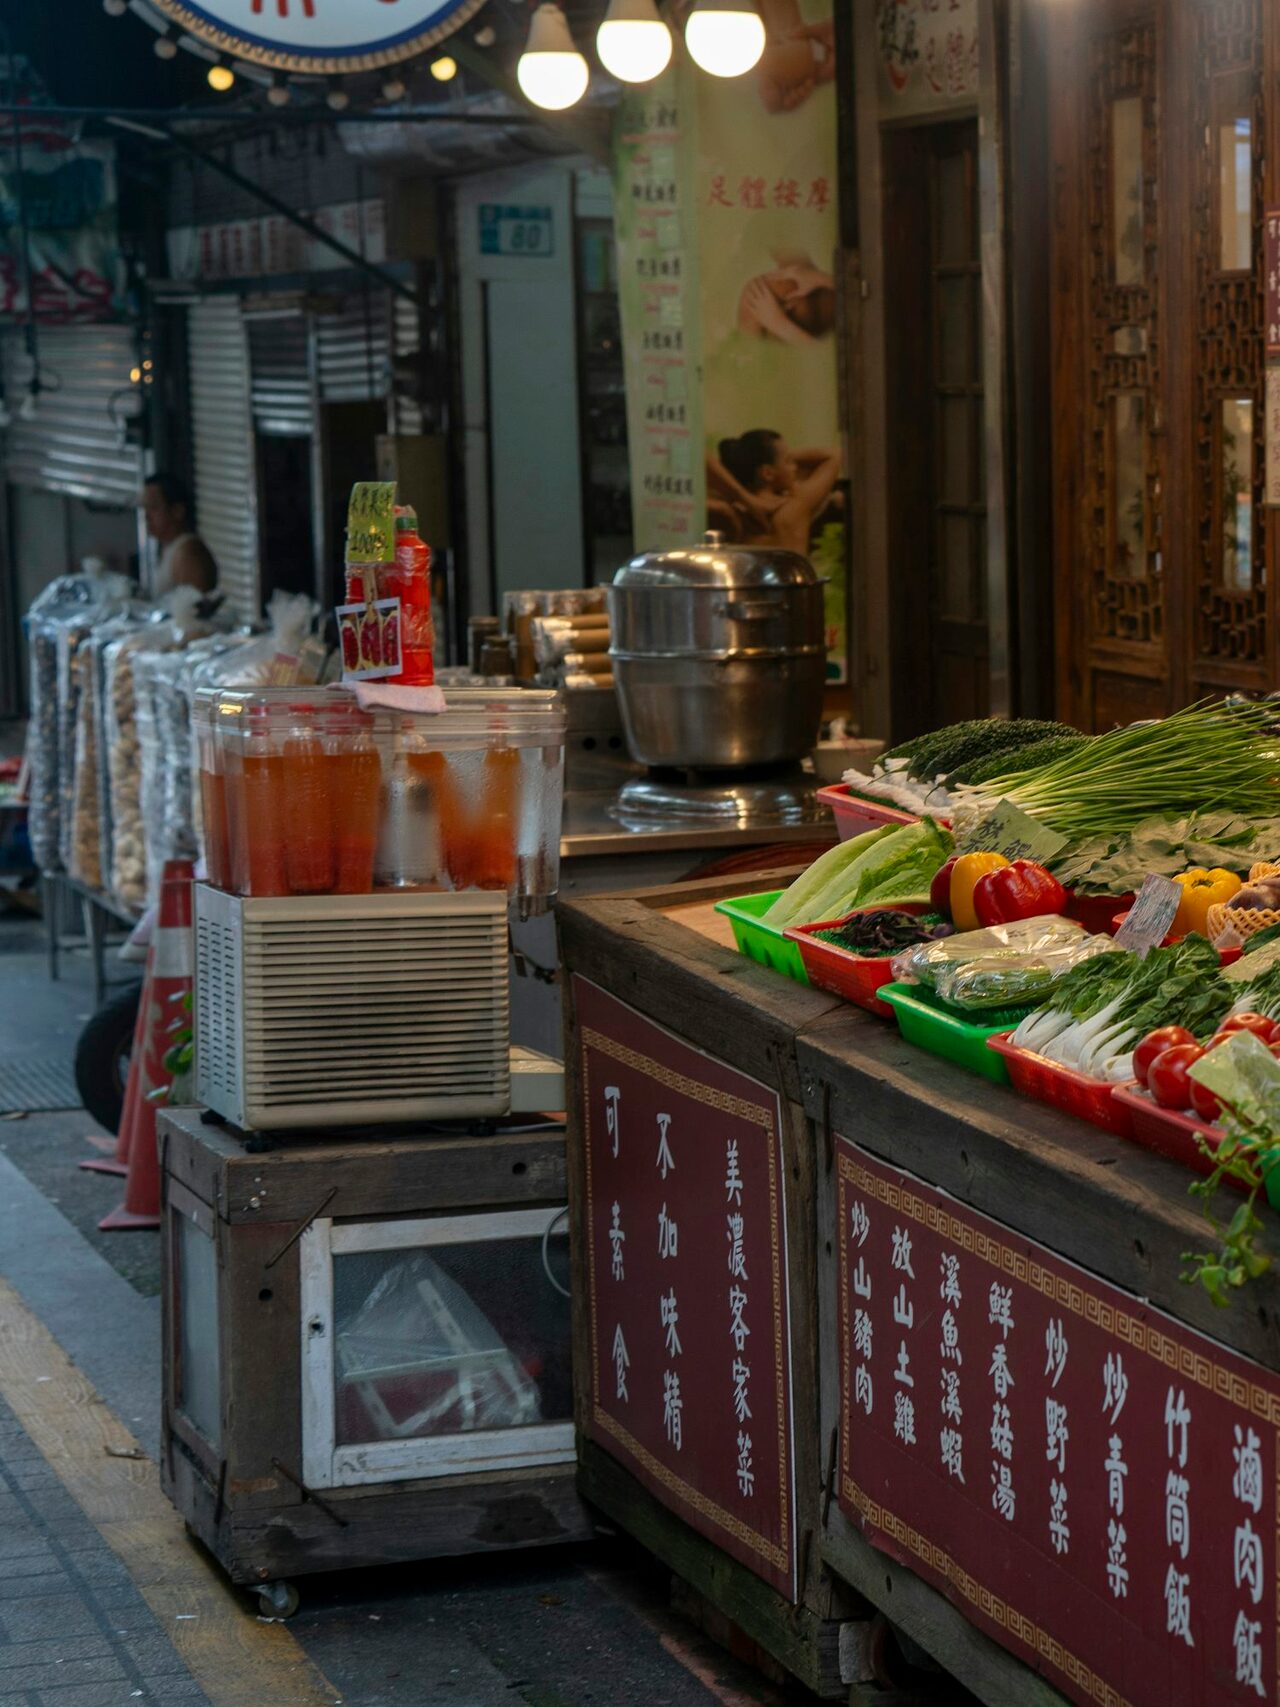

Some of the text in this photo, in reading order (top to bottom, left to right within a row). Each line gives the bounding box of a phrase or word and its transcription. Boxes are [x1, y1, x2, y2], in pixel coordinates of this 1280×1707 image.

[707, 175, 831, 213] 足體按摩
[604, 1085, 631, 1403] 可素食
[655, 1112, 683, 1452] 不加味精
[724, 1139, 756, 1498] 美濃客家菜
[850, 1199, 874, 1416] 炒山豬肉
[891, 1225, 917, 1446] 放山土雞
[939, 1251, 967, 1485] 溪魚溪蝦
[988, 1281, 1016, 1522] 鮮香菇湯
[1044, 1317, 1071, 1555] 炒野菜
[1102, 1351, 1130, 1599] 炒青菜
[1164, 1384, 1196, 1648] 竹筒飯
[1232, 1423, 1268, 1699] 滷肉飯
